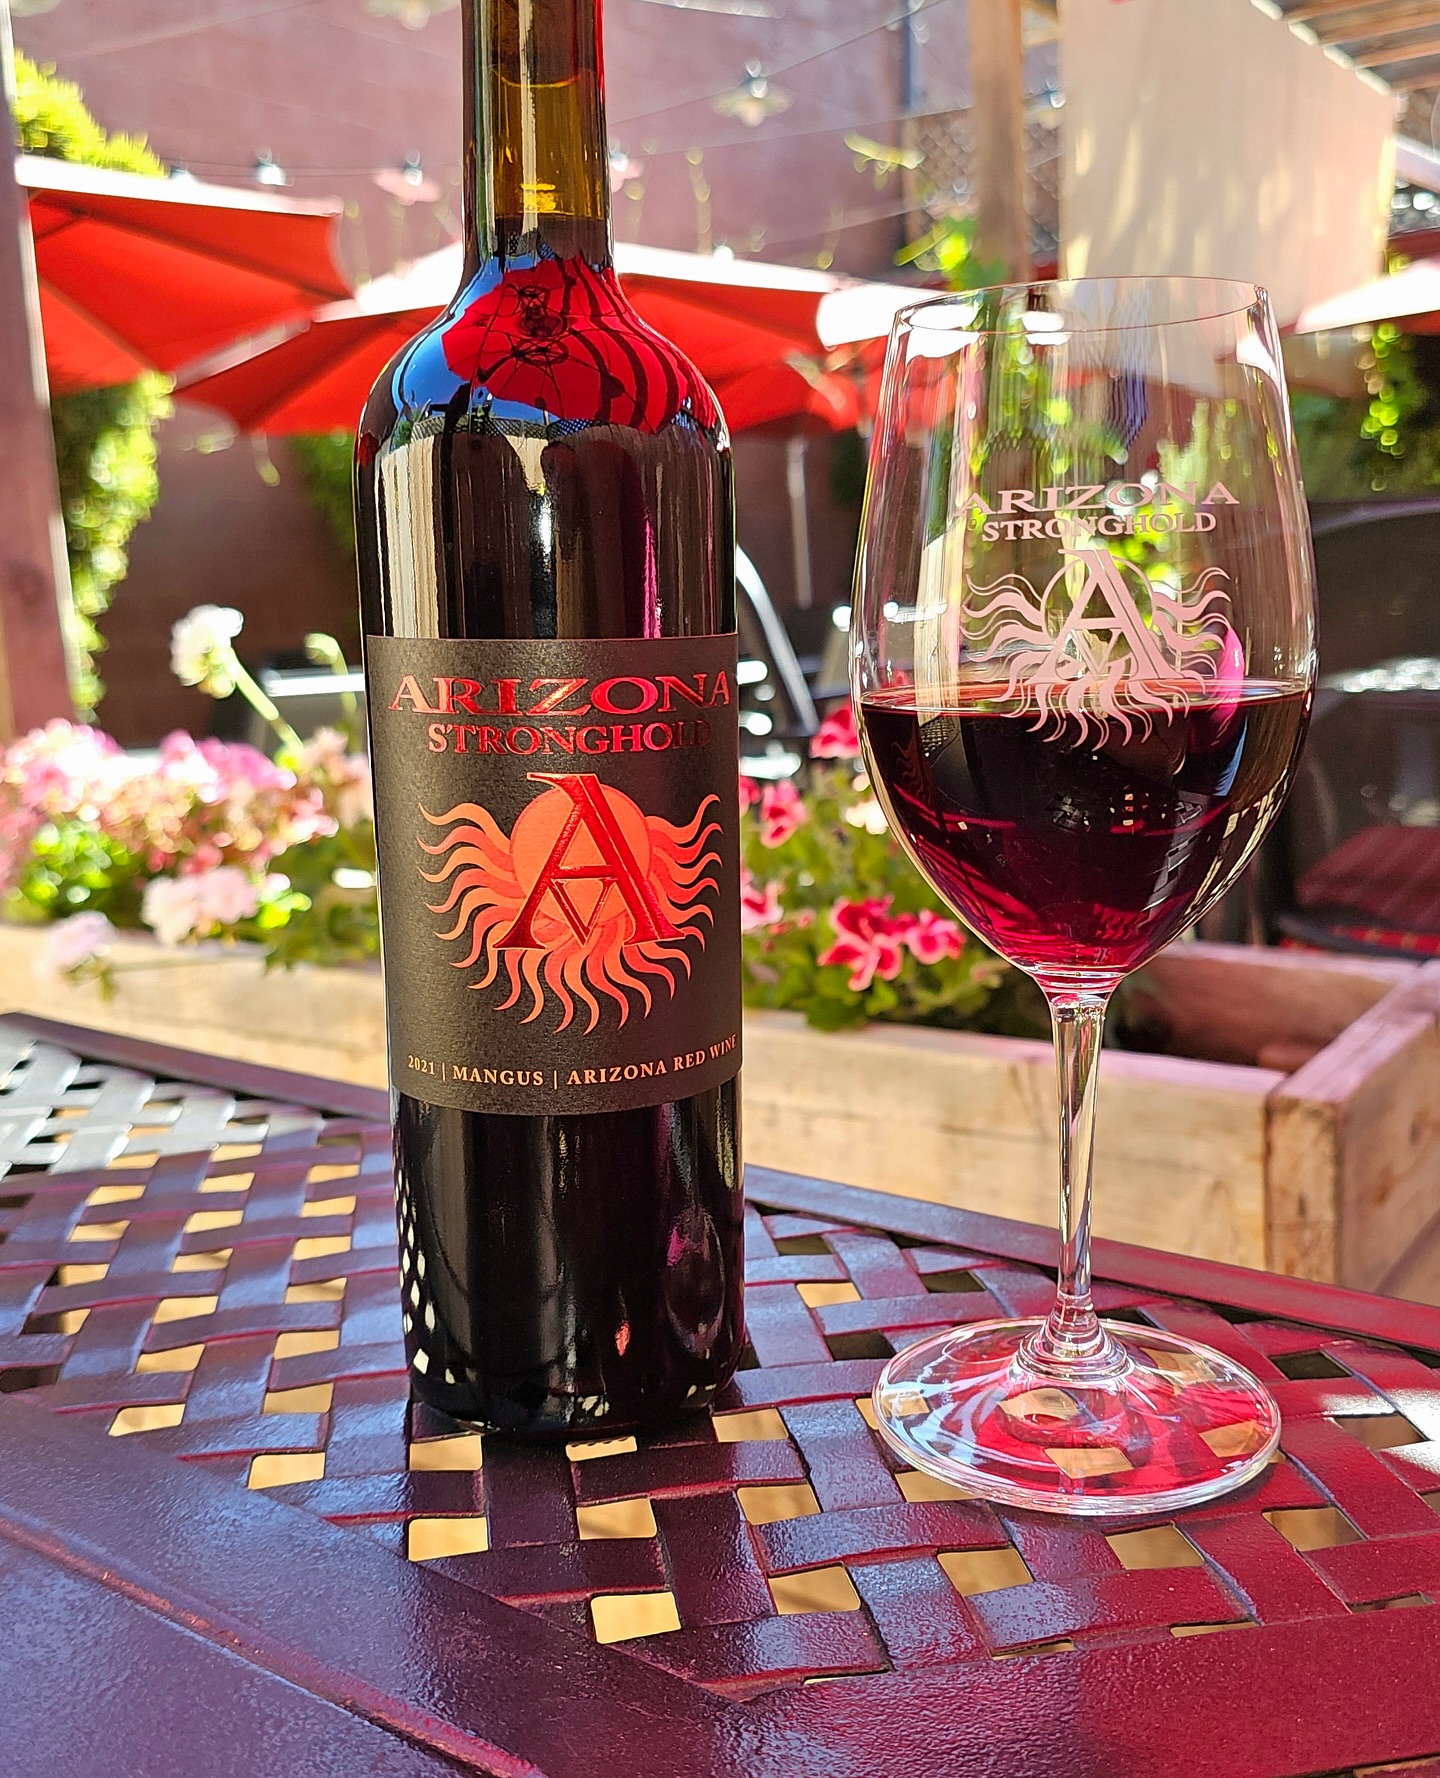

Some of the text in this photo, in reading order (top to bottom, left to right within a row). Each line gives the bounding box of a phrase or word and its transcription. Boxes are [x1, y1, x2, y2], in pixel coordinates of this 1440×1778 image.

[953, 481, 1239, 518] ARIZONA
[982, 512, 1217, 542] STRONGHOLD
[388, 670, 730, 716] ARIZONA
[428, 719, 712, 755] STRONGHOLD
[407, 1054, 436, 1076] 2021
[452, 1064, 544, 1087] MANGUS
[566, 1059, 668, 1086] ARIZONA
[672, 1050, 706, 1073] RED
[708, 1033, 738, 1060] WINE
